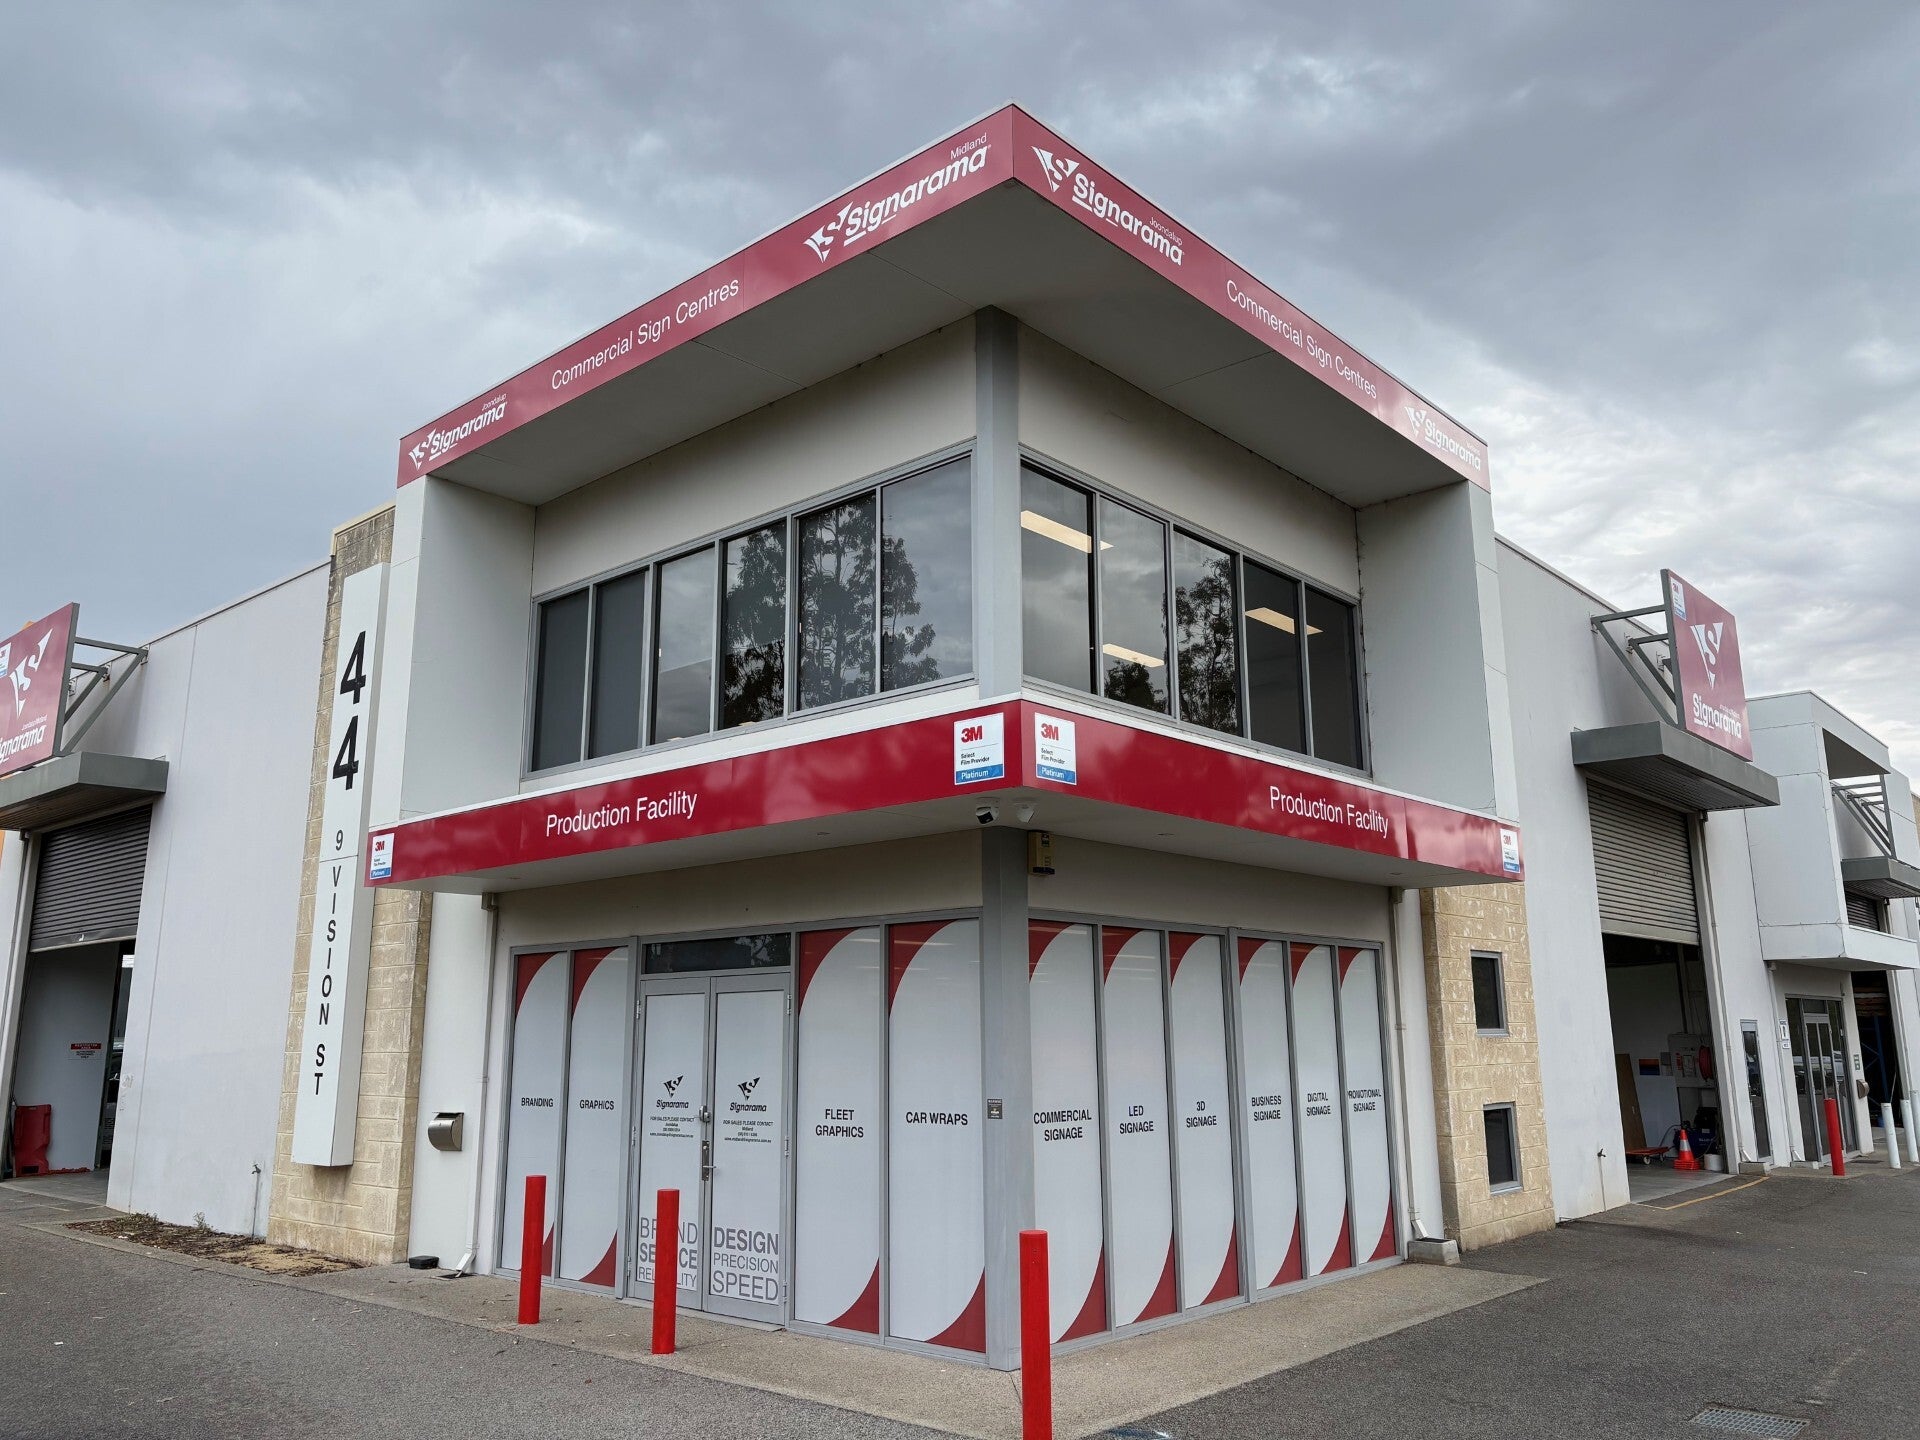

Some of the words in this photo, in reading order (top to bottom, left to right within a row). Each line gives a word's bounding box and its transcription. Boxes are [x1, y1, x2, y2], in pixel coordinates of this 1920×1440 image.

[950, 133, 987, 160] Midland
[844, 144, 989, 239] Signarama
[1073, 172, 1183, 266] Signarama
[1149, 216, 1183, 246] Joondalup
[552, 331, 633, 390] Commercial
[637, 314, 671, 345] Sign
[676, 279, 739, 325] Centres
[1226, 279, 1303, 348] Commercial
[1306, 334, 1332, 369] Sign
[1335, 356, 1377, 400] Centres
[431, 402, 506, 454] Signarama
[1424, 418, 1481, 471] Signarama
[1692, 692, 1742, 740] Signarama
[961, 725, 983, 743] 3M
[1041, 723, 1059, 741] 3M
[0, 724, 48, 764] gnarama
[1041, 747, 1054, 755] Select
[961, 770, 989, 780] Platinum
[1041, 767, 1065, 779] Platinum
[546, 805, 630, 837] Production
[636, 790, 698, 822] Facility
[1270, 785, 1344, 825] Production
[1347, 803, 1389, 839] Facility
[335, 829, 344, 851] 9
[319, 866, 342, 1026] VISION
[314, 1043, 326, 1096] ST
[521, 1097, 554, 1108] BRANDING
[579, 1099, 615, 1111] GRAPHICS
[656, 1099, 689, 1110] Signarama
[1196, 1100, 1206, 1112] 3D
[1251, 1095, 1282, 1107] BUSINESS
[1307, 1092, 1329, 1103] DIGITAL
[730, 1102, 767, 1113] Signarama
[825, 1108, 854, 1121] FLEET
[1128, 1105, 1144, 1117] LED
[1253, 1109, 1281, 1122] SIGNAGE
[1306, 1105, 1331, 1117] SIGNAGE
[1353, 1101, 1376, 1113] SIGNAGE
[906, 1112, 927, 1124] CAR
[929, 1112, 969, 1126] WRAPS
[1033, 1109, 1092, 1125] COMMERCIAL
[1186, 1115, 1217, 1129] SIGNAGE
[815, 1124, 864, 1138] GRAPHICS
[1044, 1127, 1083, 1142] SIGNAGE
[1119, 1121, 1154, 1135] SIGNAGE
[640, 1217, 698, 1245] BND
[714, 1226, 779, 1256] DESIGN
[639, 1242, 698, 1270] SECE
[713, 1252, 779, 1274] PRECISION
[638, 1266, 697, 1288] RELITY
[712, 1270, 779, 1301] SPEED
